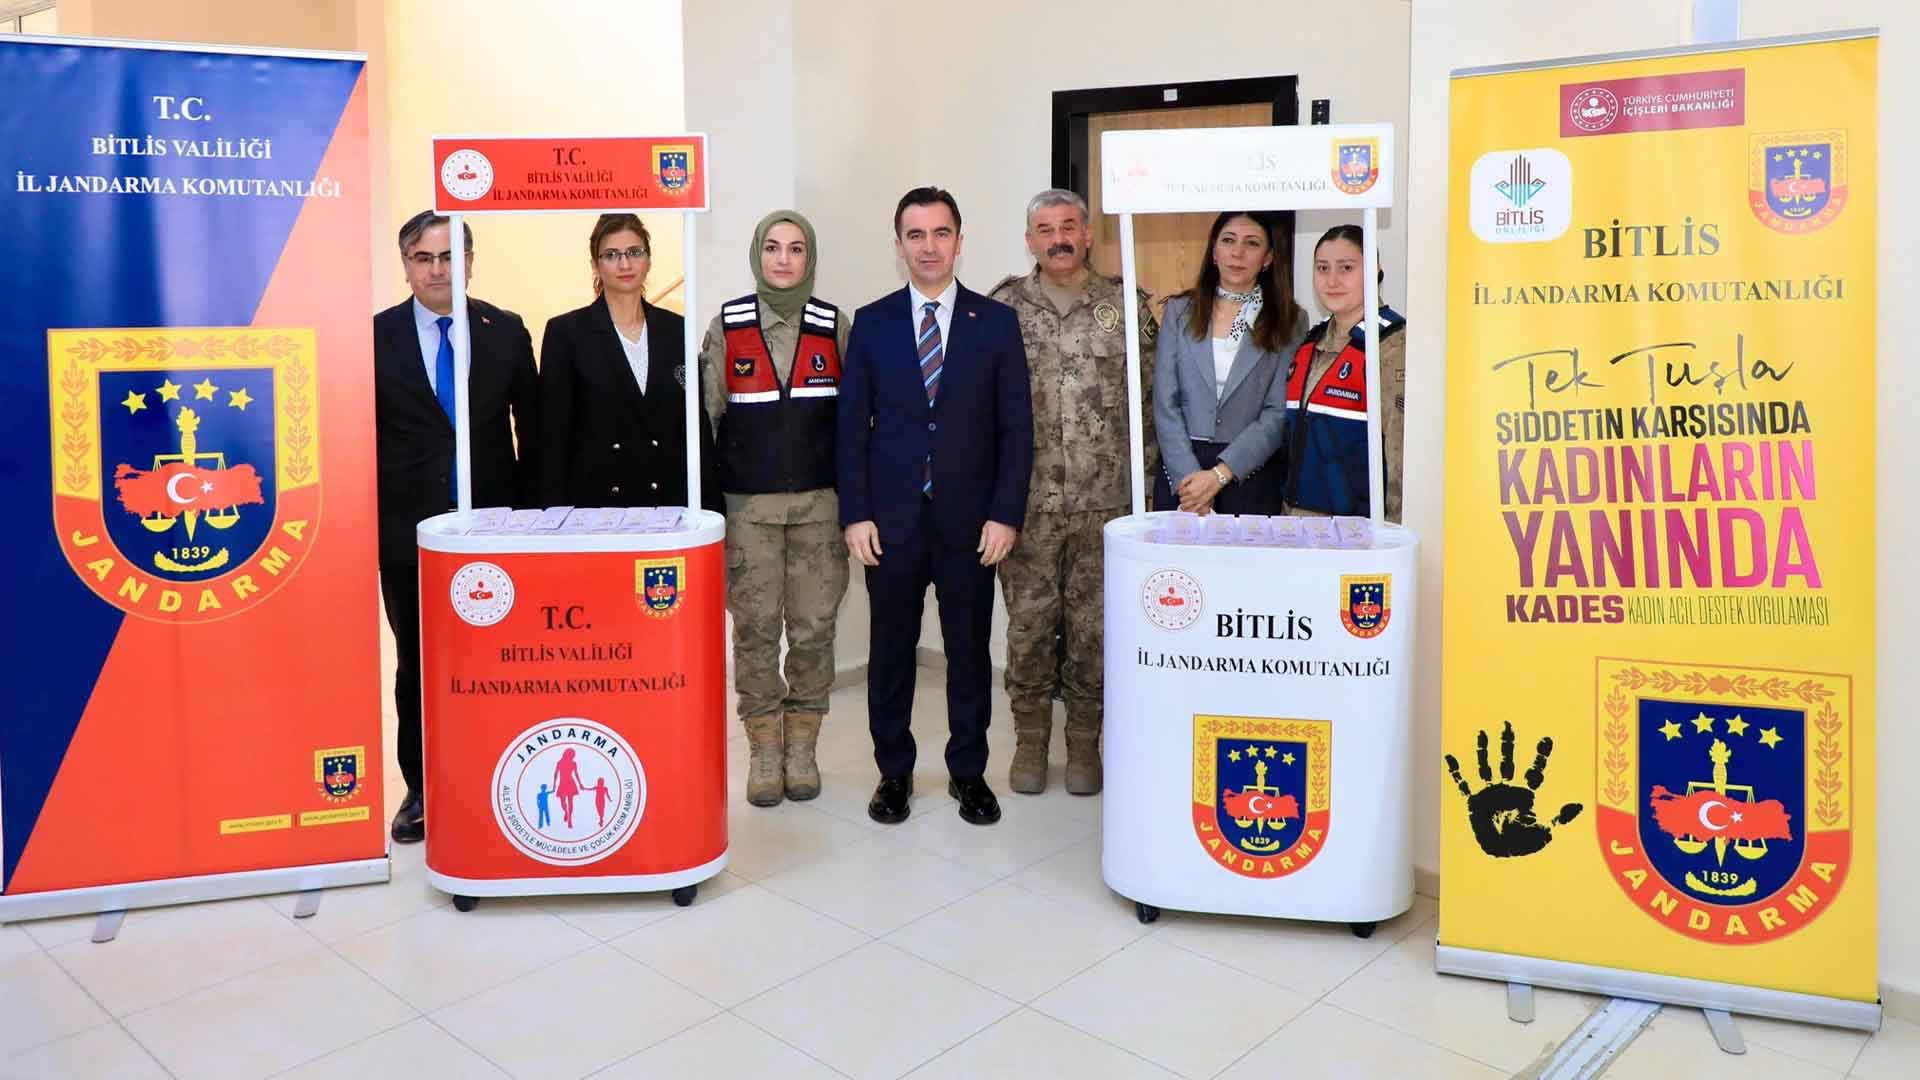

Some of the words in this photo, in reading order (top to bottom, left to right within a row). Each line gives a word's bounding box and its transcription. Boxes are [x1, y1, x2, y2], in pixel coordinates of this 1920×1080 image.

[153, 96, 211, 121] T.C.
[1623, 94, 1663, 106] TÜRKİYE
[1665, 88, 1734, 103] CUMHURİYETİ
[1623, 104, 1668, 118] İÇİŞLERİ
[1672, 99, 1734, 113] BAKANLIĞI
[92, 134, 167, 156] BİTLİS
[173, 137, 273, 160] VALİLİĞİ
[553, 147, 586, 166] T.C.
[16, 171, 42, 193] İL
[46, 175, 177, 195] JANDARMA
[182, 177, 341, 198] KOMUTANLIĞI
[527, 168, 563, 184] BİTLİS
[564, 167, 614, 184] VALİLİĞİ
[507, 188, 567, 201] JANDARMA
[569, 185, 648, 200] KOMUTANLIĞI
[1496, 208, 1544, 226] BİTLİS
[1583, 217, 1720, 259] BİTLİS
[1474, 281, 1496, 306] İL
[1502, 283, 1639, 306] JANDARMA
[1648, 274, 1844, 304] KOMUTANLIĞI
[1492, 347, 1605, 408] Tek
[1610, 334, 1794, 405] Tuşla
[1496, 407, 1623, 445] ŞİDDETİN
[1631, 400, 1811, 439] KARŞISINDA
[1497, 440, 1817, 505] KADINLARIN
[171, 546, 210, 559] 1839
[1502, 507, 1823, 588] YANINDA
[71, 517, 309, 612] JANDARMA
[541, 606, 592, 630] T.C.
[1506, 594, 1625, 625] KADES
[1627, 596, 1665, 625] KADIN
[1669, 596, 1696, 625] ACİL
[1699, 596, 1745, 625] DESTEK
[1749, 595, 1831, 626] UYGULAMASI
[1216, 608, 1312, 641] BİTLİS
[501, 644, 554, 662] BİTLİS
[558, 642, 633, 661] VALİLİĞİ
[1138, 647, 1154, 667] İL
[1156, 652, 1256, 674] JANDARMA
[1261, 658, 1391, 677] KOMUTANLIĞI
[451, 675, 466, 694] İL
[467, 677, 562, 695] JANDARMA
[566, 674, 687, 694] KOMUTANLIĞI
[517, 728, 619, 763] JANDARMA
[1200, 822, 1323, 873] JANDARMA
[1250, 836, 1271, 845] 1839
[1610, 839, 1836, 936] JANDARMA
[1701, 869, 1740, 885] 1839
